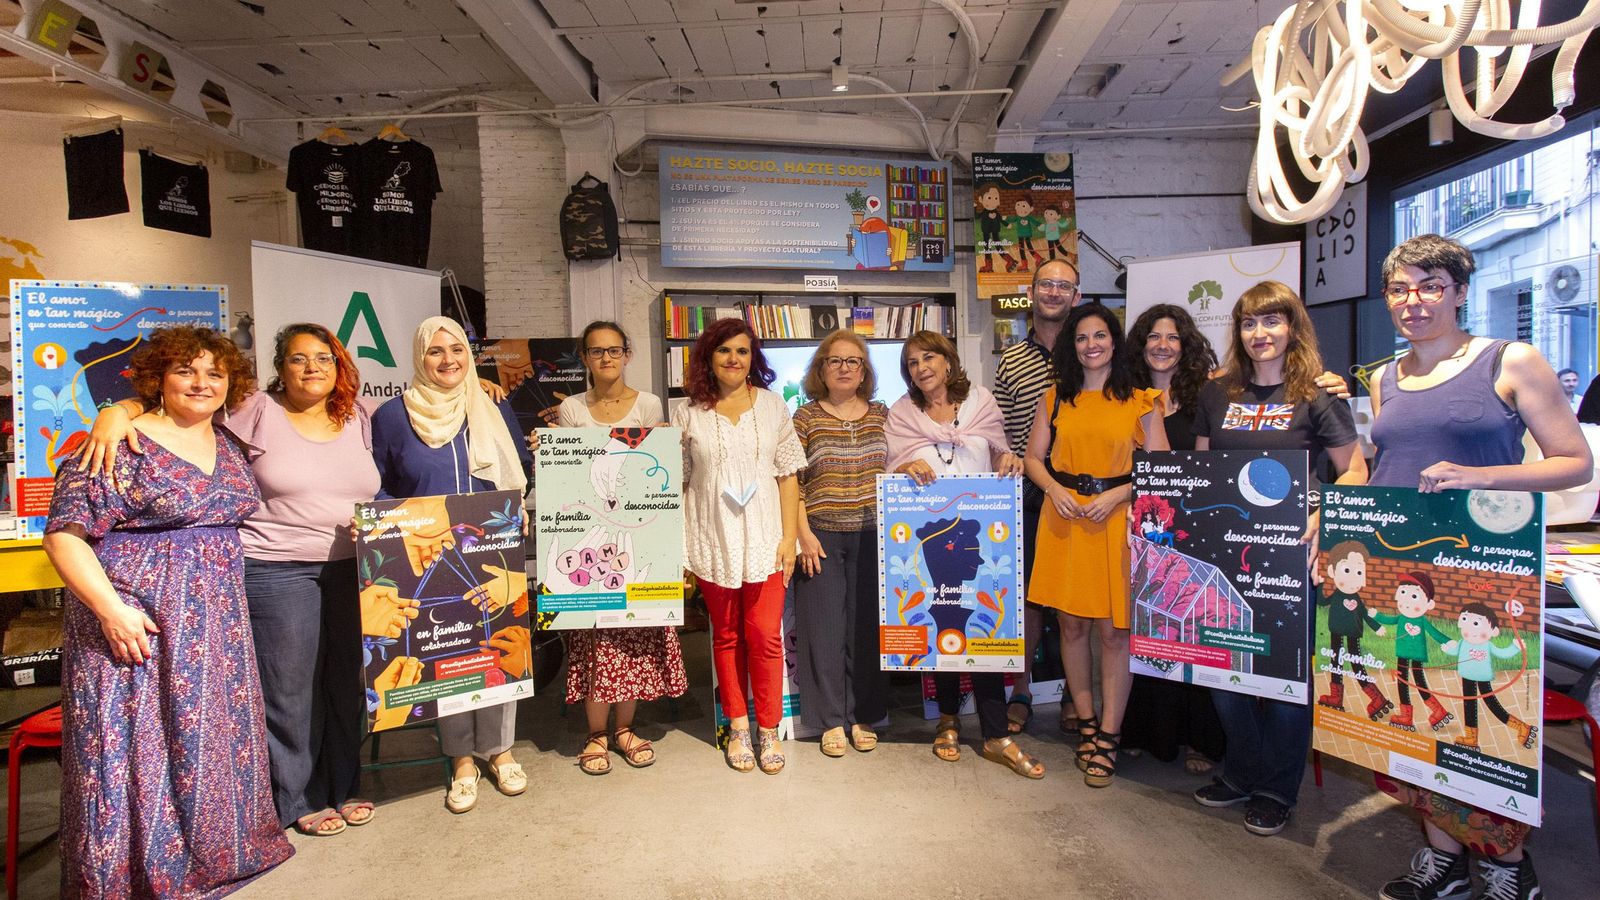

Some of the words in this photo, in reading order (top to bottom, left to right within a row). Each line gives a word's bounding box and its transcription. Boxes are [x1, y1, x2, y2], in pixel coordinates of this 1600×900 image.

[39, 12, 68, 48] E
[133, 53, 150, 83] S
[671, 156, 723, 170] HAZTE
[784, 162, 834, 175] HAZTE
[839, 164, 882, 177] SOCIA
[724, 207, 766, 215] PROTEGIDO
[27, 292, 46, 304] El
[50, 294, 88, 305] amor
[27, 309, 42, 318] es
[45, 307, 70, 318] tan
[73, 308, 124, 323] mágico
[28, 322, 46, 331] que
[540, 434, 553, 444] El
[556, 436, 583, 444] amor
[552, 447, 570, 456] tan
[572, 447, 608, 459] mágico
[1136, 461, 1151, 473] El
[1153, 464, 1183, 474] amor
[887, 483, 899, 493] El
[1150, 476, 1168, 486] tan
[1170, 476, 1211, 490] mágico
[1136, 490, 1150, 498] que
[1150, 488, 1182, 497] convierte
[1325, 492, 1341, 504] El
[1343, 496, 1377, 507] amor
[624, 500, 680, 510] desconocidas
[898, 494, 914, 503] tan
[915, 494, 948, 506] mágico
[957, 501, 1012, 511] desconocidas
[361, 508, 377, 520] El
[379, 508, 409, 518] amor
[555, 512, 591, 525] familia
[1325, 510, 1337, 518] es
[1339, 507, 1360, 520] tan
[1362, 509, 1408, 527] mágico
[376, 520, 396, 530] tan
[397, 518, 436, 530] mágico
[1262, 523, 1300, 532] personas
[1325, 523, 1339, 531] que
[1340, 522, 1375, 533] convierte
[363, 535, 378, 544] que
[491, 530, 520, 541] personas
[1224, 529, 1300, 546] desconocidas
[462, 540, 521, 554] desconocidas
[1472, 545, 1481, 553] a
[1482, 546, 1534, 560] personas
[1433, 552, 1534, 576] desconocidas
[1236, 574, 1252, 583] en
[1254, 571, 1302, 588] familia
[939, 584, 975, 597] familia
[1243, 589, 1302, 602] colaboradora
[416, 630, 431, 640] en
[433, 621, 474, 640] familia
[421, 638, 471, 652] colaboradora
[1320, 647, 1337, 660] en
[1337, 647, 1385, 670] familia
[1320, 664, 1377, 684] colaboradora
[1442, 747, 1528, 779] #contigohastalaluna
[1448, 761, 1527, 789] www.crecerconfuturo.org
